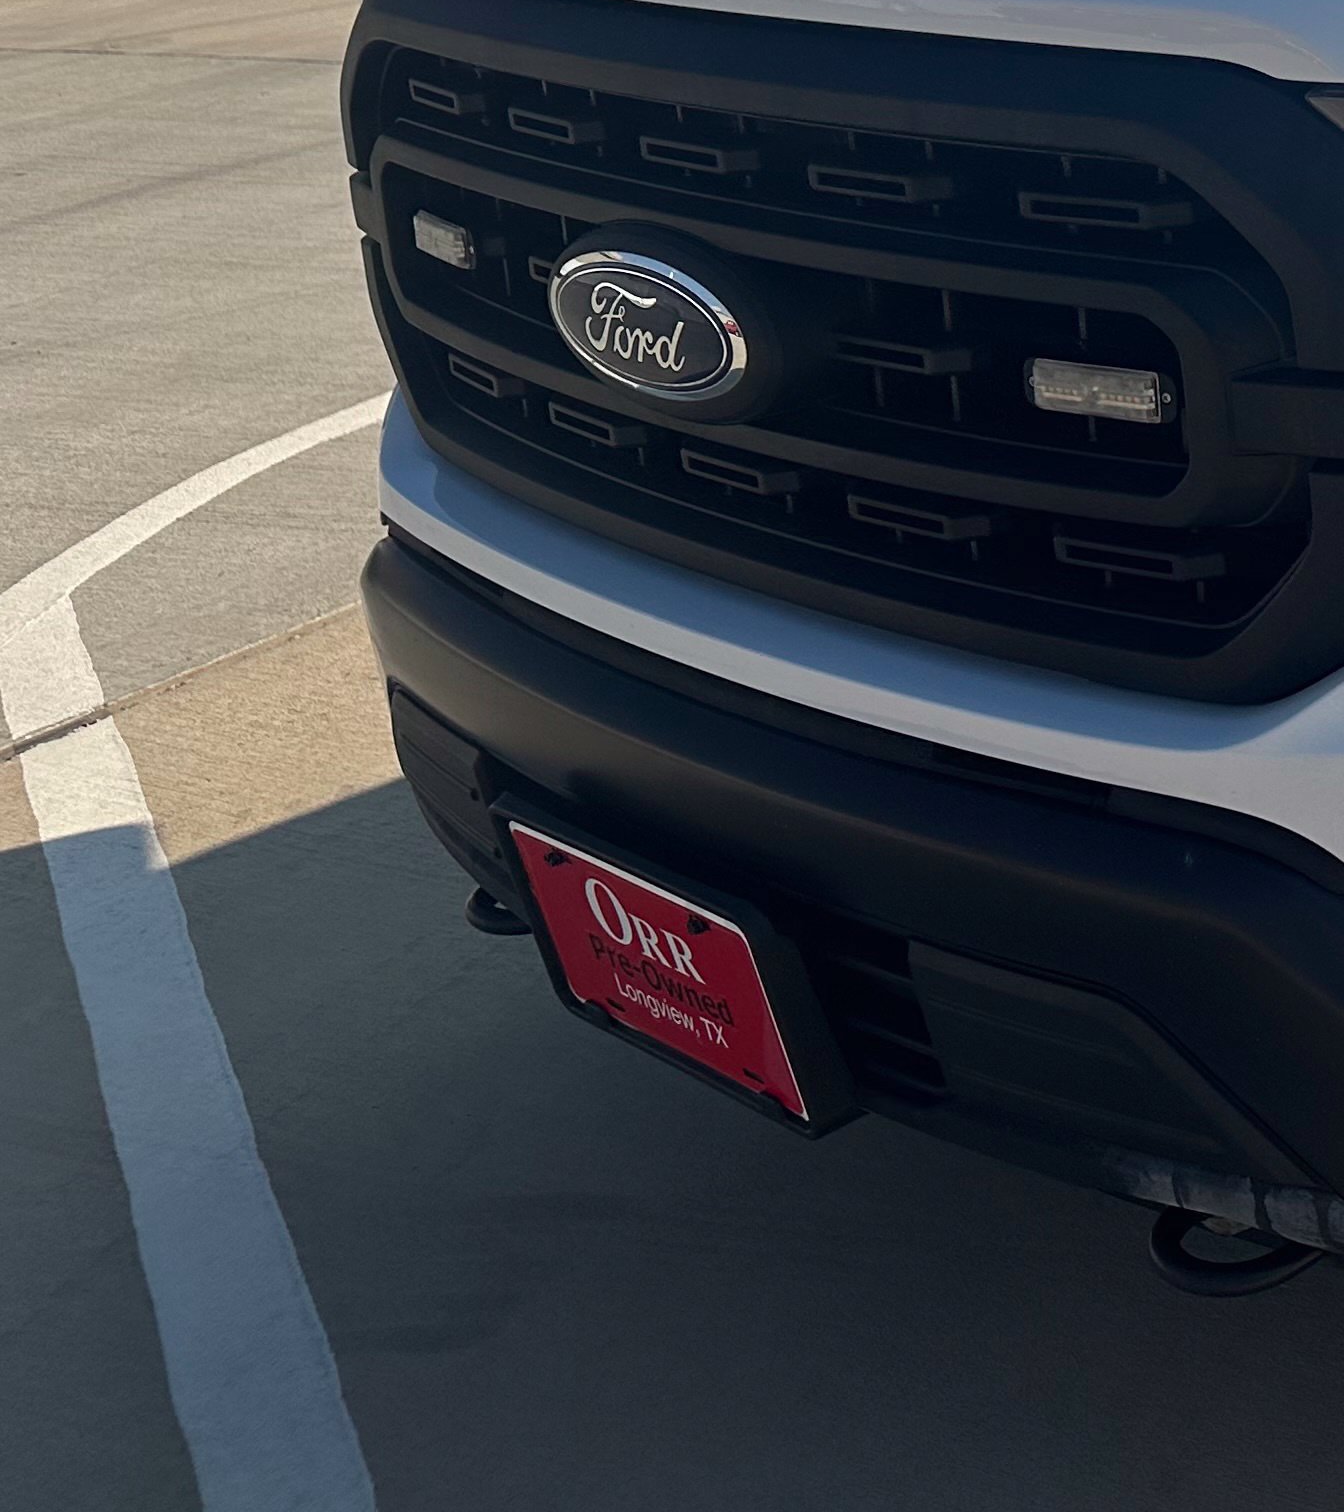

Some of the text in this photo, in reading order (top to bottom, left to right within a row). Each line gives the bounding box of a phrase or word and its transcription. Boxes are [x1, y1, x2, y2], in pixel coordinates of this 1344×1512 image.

[585, 281, 686, 372] Ford
[585, 877, 707, 985] ORR
[588, 931, 734, 1027] Pre-Owned
[699, 1018, 729, 1049] TX
